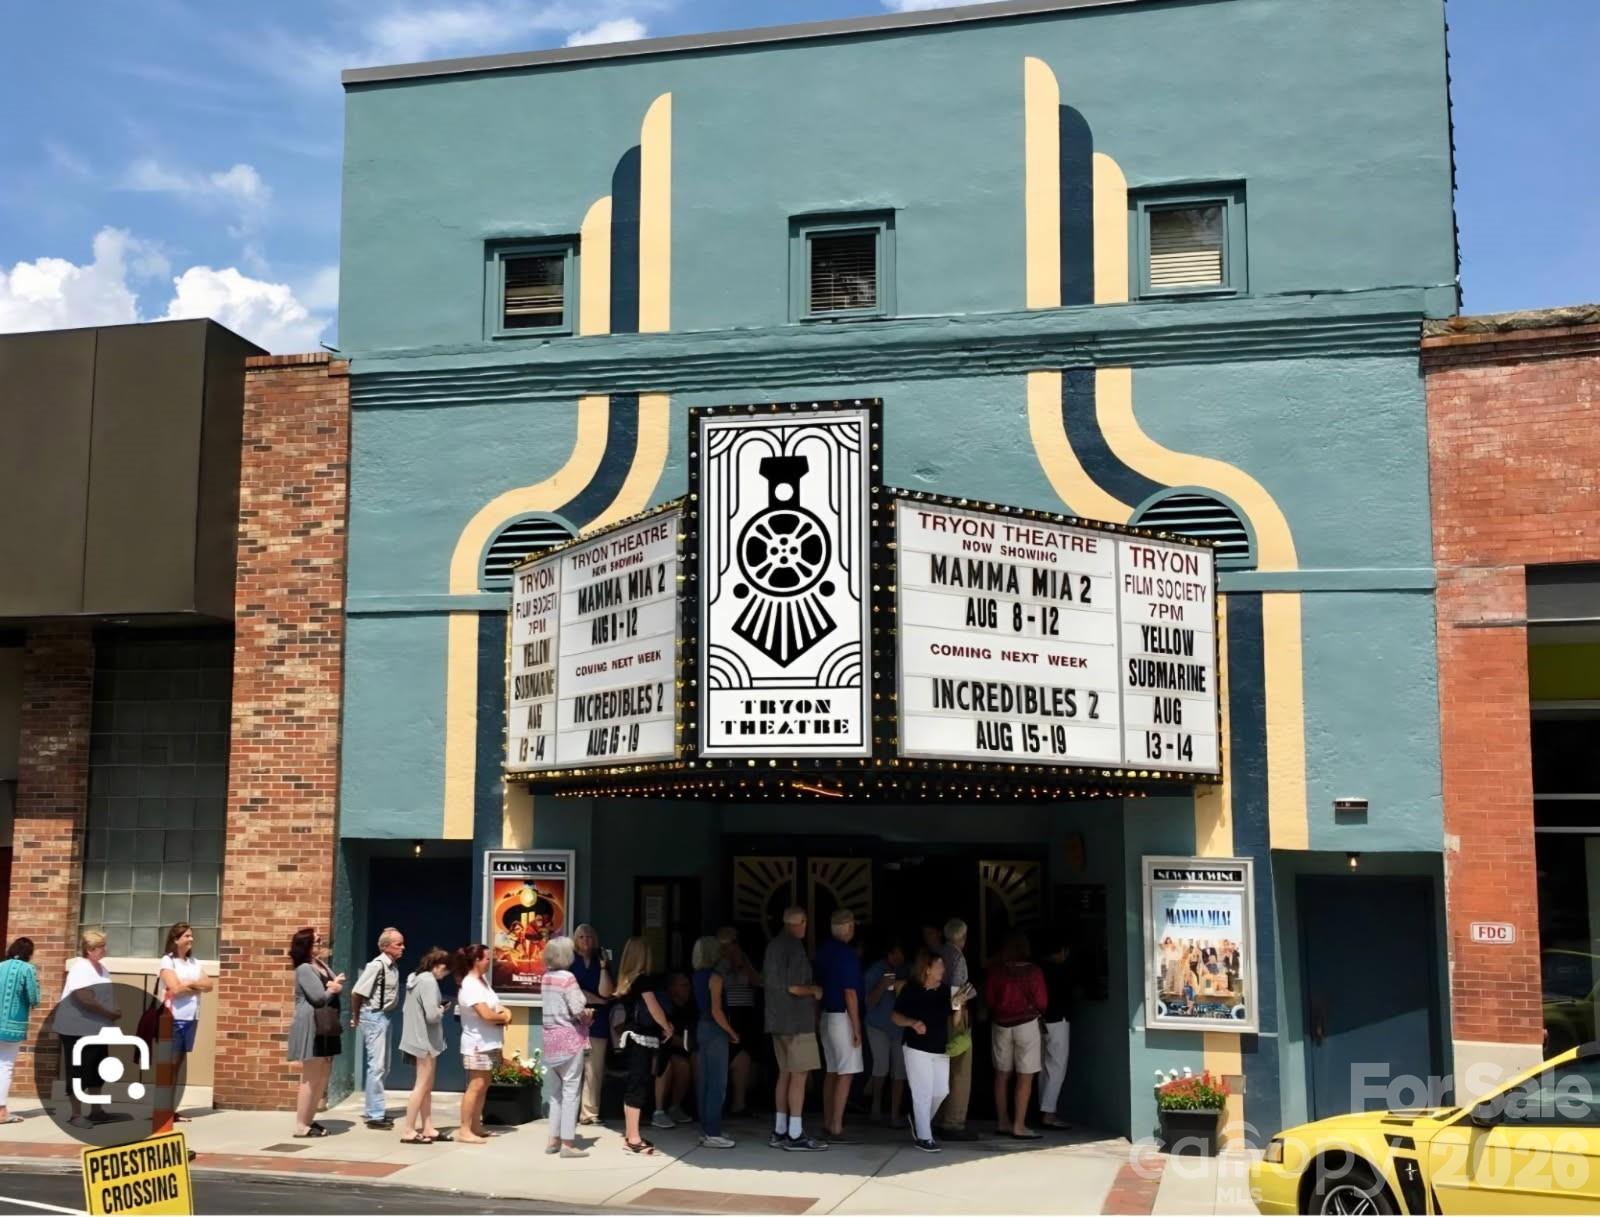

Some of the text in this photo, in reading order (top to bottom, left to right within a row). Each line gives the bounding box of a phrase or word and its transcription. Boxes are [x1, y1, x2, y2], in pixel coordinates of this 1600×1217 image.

[572, 523, 668, 570] TRYON THEATRE
[918, 512, 1097, 554] TRYON THEATRE
[963, 539, 1057, 563] NOW SHOWING
[1130, 546, 1198, 576] TRYON
[520, 567, 555, 594] TRYON
[578, 564, 665, 615] MAMMA MIA 2
[931, 554, 1091, 603] MAMMA MIA 2
[1125, 574, 1206, 603] FILM SOCIETY
[966, 597, 997, 628] AUG
[1148, 603, 1184, 621] 7PM
[930, 643, 1088, 668] COMING NEXT WEEK
[1141, 625, 1194, 656] YELLOW
[576, 650, 662, 676] COMING NEXT WEEK
[1129, 658, 1206, 692] SUBMARINE
[574, 683, 664, 723] INCREDIBLES 2
[740, 699, 831, 714] TRYON
[932, 677, 1099, 719] INCREDIBLES 2
[1153, 696, 1182, 725] AUG
[587, 728, 608, 756] AUG
[721, 719, 849, 735] THEATRE
[976, 720, 1066, 754] AUG 15-19
[1166, 907, 1204, 925] MAMMA
[1478, 926, 1506, 939] FDC
[90, 1141, 182, 1184] PEDESTRIAN
[102, 1173, 178, 1214] CROSSING
